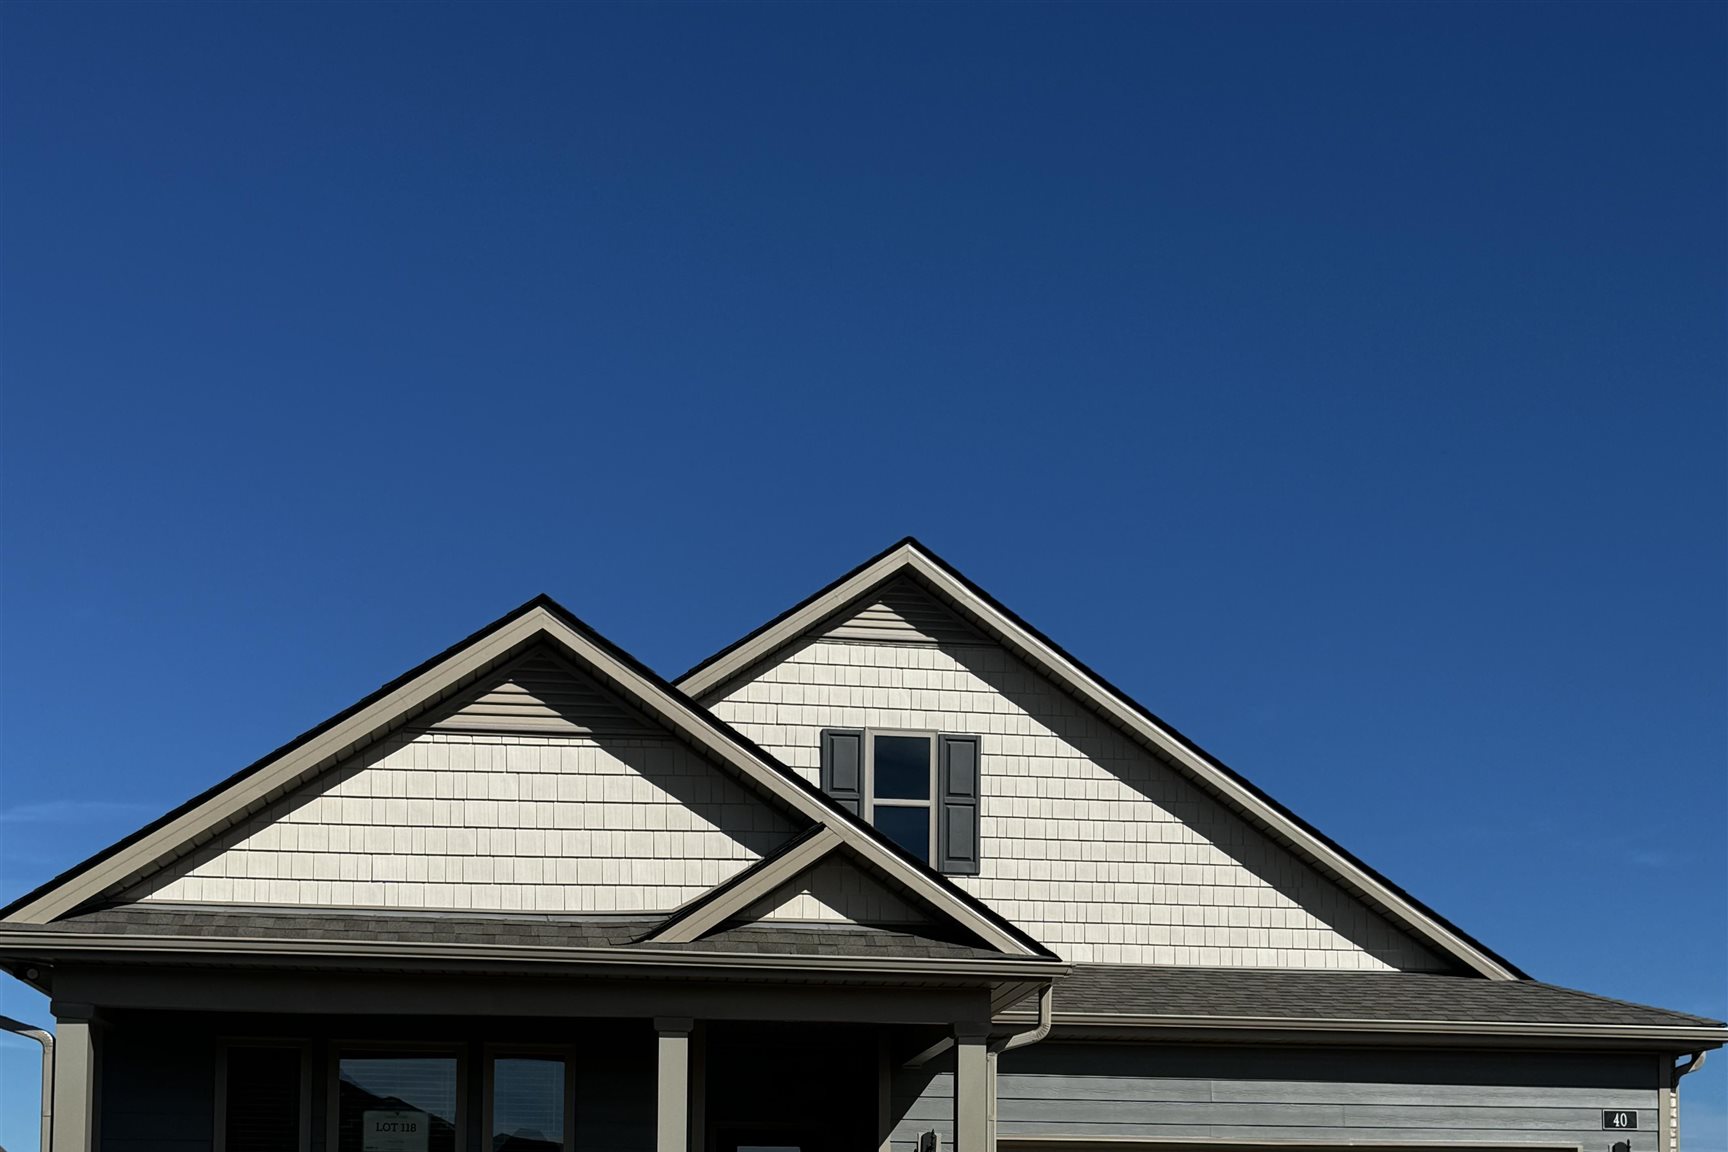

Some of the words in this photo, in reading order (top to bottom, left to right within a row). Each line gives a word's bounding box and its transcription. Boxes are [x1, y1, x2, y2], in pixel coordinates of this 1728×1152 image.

[1613, 1112, 1628, 1127] 40
[376, 1122, 398, 1132] LOT
[400, 1122, 416, 1132] 118
